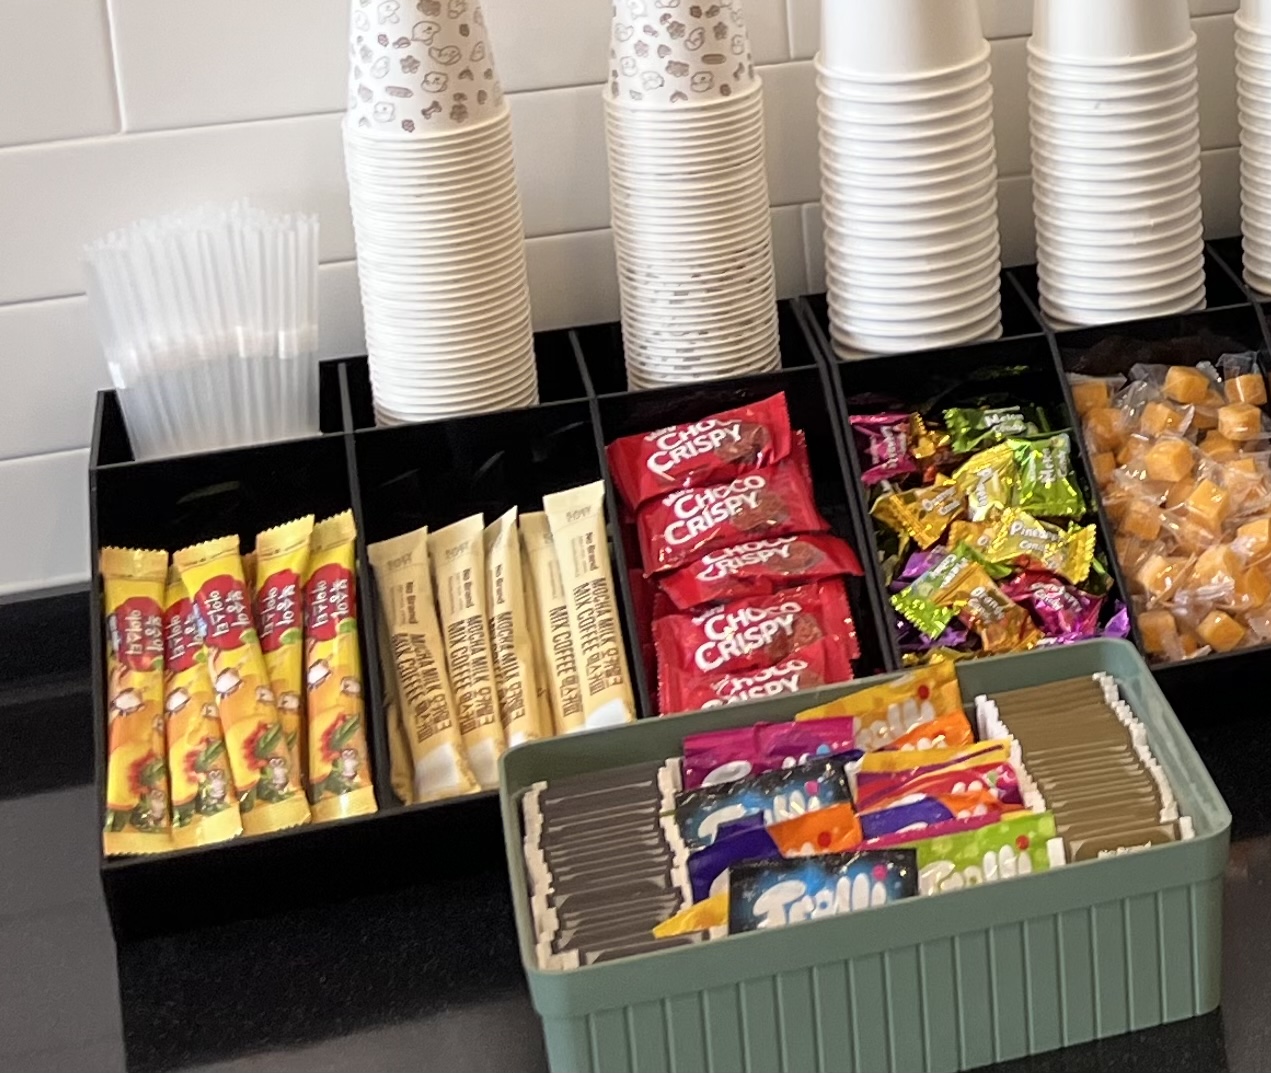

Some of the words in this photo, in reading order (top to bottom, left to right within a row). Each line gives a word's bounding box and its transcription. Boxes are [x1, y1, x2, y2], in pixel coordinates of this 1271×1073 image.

[647, 424, 741, 474] CRISPY
[657, 419, 741, 450] CHO
[674, 475, 766, 519] CHOCO
[664, 491, 759, 545] CRISPY
[696, 544, 790, 581] CRISPY
[573, 582, 592, 610] MIX
[591, 578, 612, 618] MOCHA
[447, 619, 467, 648] MIX
[467, 615, 487, 655] MOCHA
[549, 605, 570, 628] MIX
[576, 608, 600, 656] COFFEE
[598, 617, 617, 646] MILK
[704, 602, 801, 640] CHOCO
[552, 630, 576, 677] COFFEE
[695, 614, 794, 671] CRISPY
[396, 658, 425, 705] COFFEE
[450, 647, 471, 694] COFFEE
[471, 656, 490, 685] MILK
[753, 865, 888, 928] Trolli
